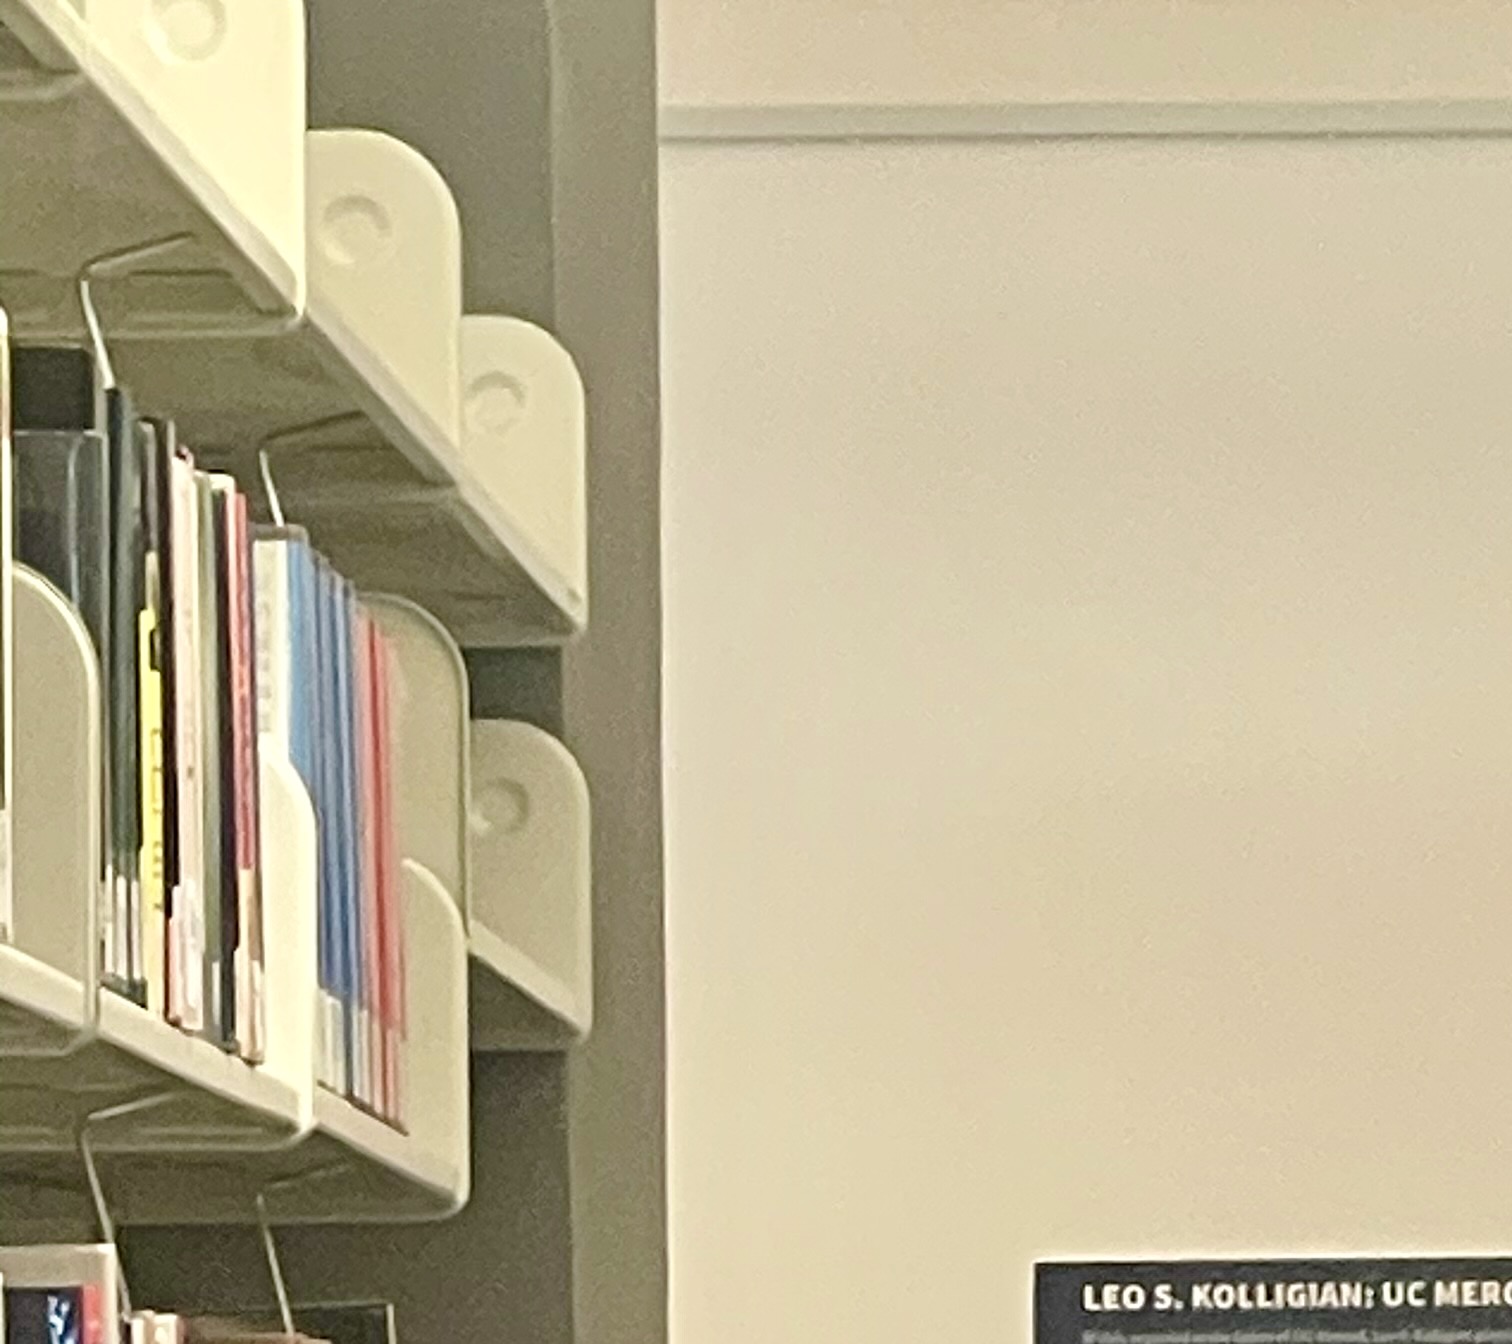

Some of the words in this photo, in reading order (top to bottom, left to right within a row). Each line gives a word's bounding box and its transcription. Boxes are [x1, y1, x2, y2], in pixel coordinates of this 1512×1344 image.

[1083, 1283, 1146, 1311] LEO
[1154, 1283, 1183, 1310] S.
[1192, 1281, 1374, 1310] KOLLIGIAN:
[1382, 1281, 1427, 1308] UC
